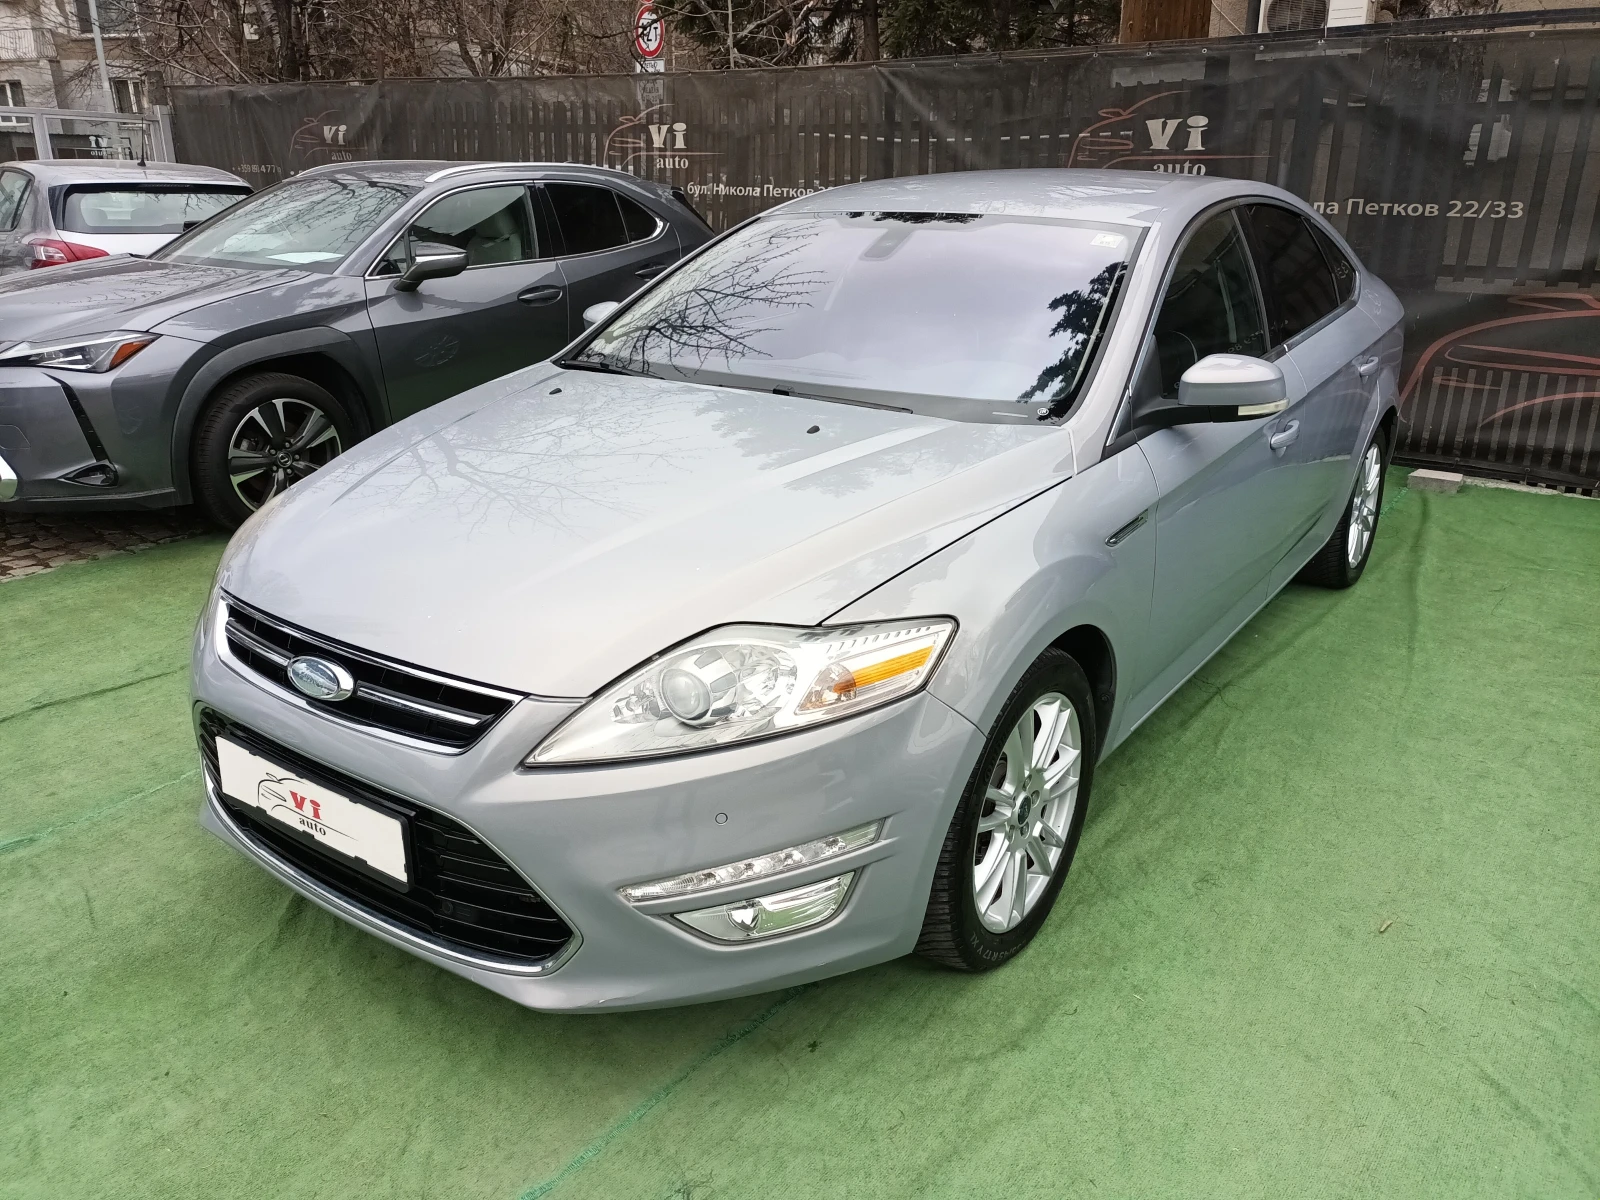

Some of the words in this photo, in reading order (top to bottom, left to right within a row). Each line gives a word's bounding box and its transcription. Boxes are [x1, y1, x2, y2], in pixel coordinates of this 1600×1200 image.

[331, 150, 352, 161] auto
[656, 155, 689, 169] auto
[1153, 160, 1206, 176] auto
[713, 183, 760, 197] Никола
[1346, 198, 1440, 217] Петков
[1446, 200, 1524, 219] 22/33
[299, 817, 327, 836] auto
